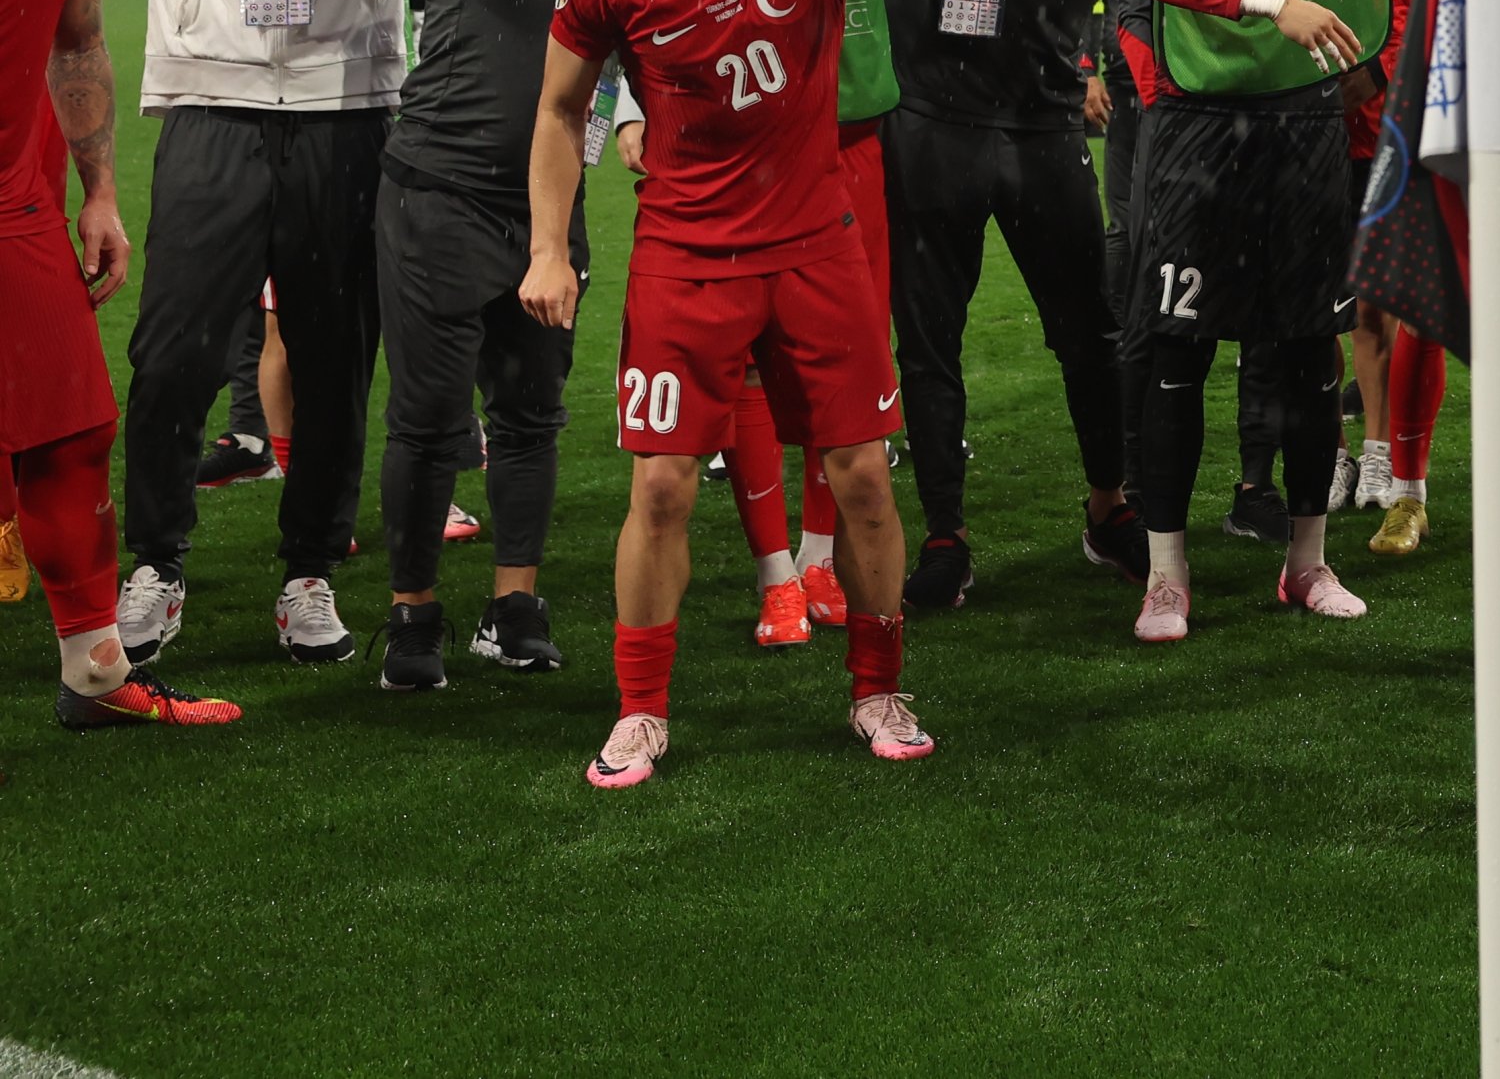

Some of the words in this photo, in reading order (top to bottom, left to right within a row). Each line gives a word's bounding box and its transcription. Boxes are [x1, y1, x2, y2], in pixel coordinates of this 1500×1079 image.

[715, 39, 787, 112] 20
[1160, 262, 1203, 320] 12
[624, 367, 680, 434] 20
